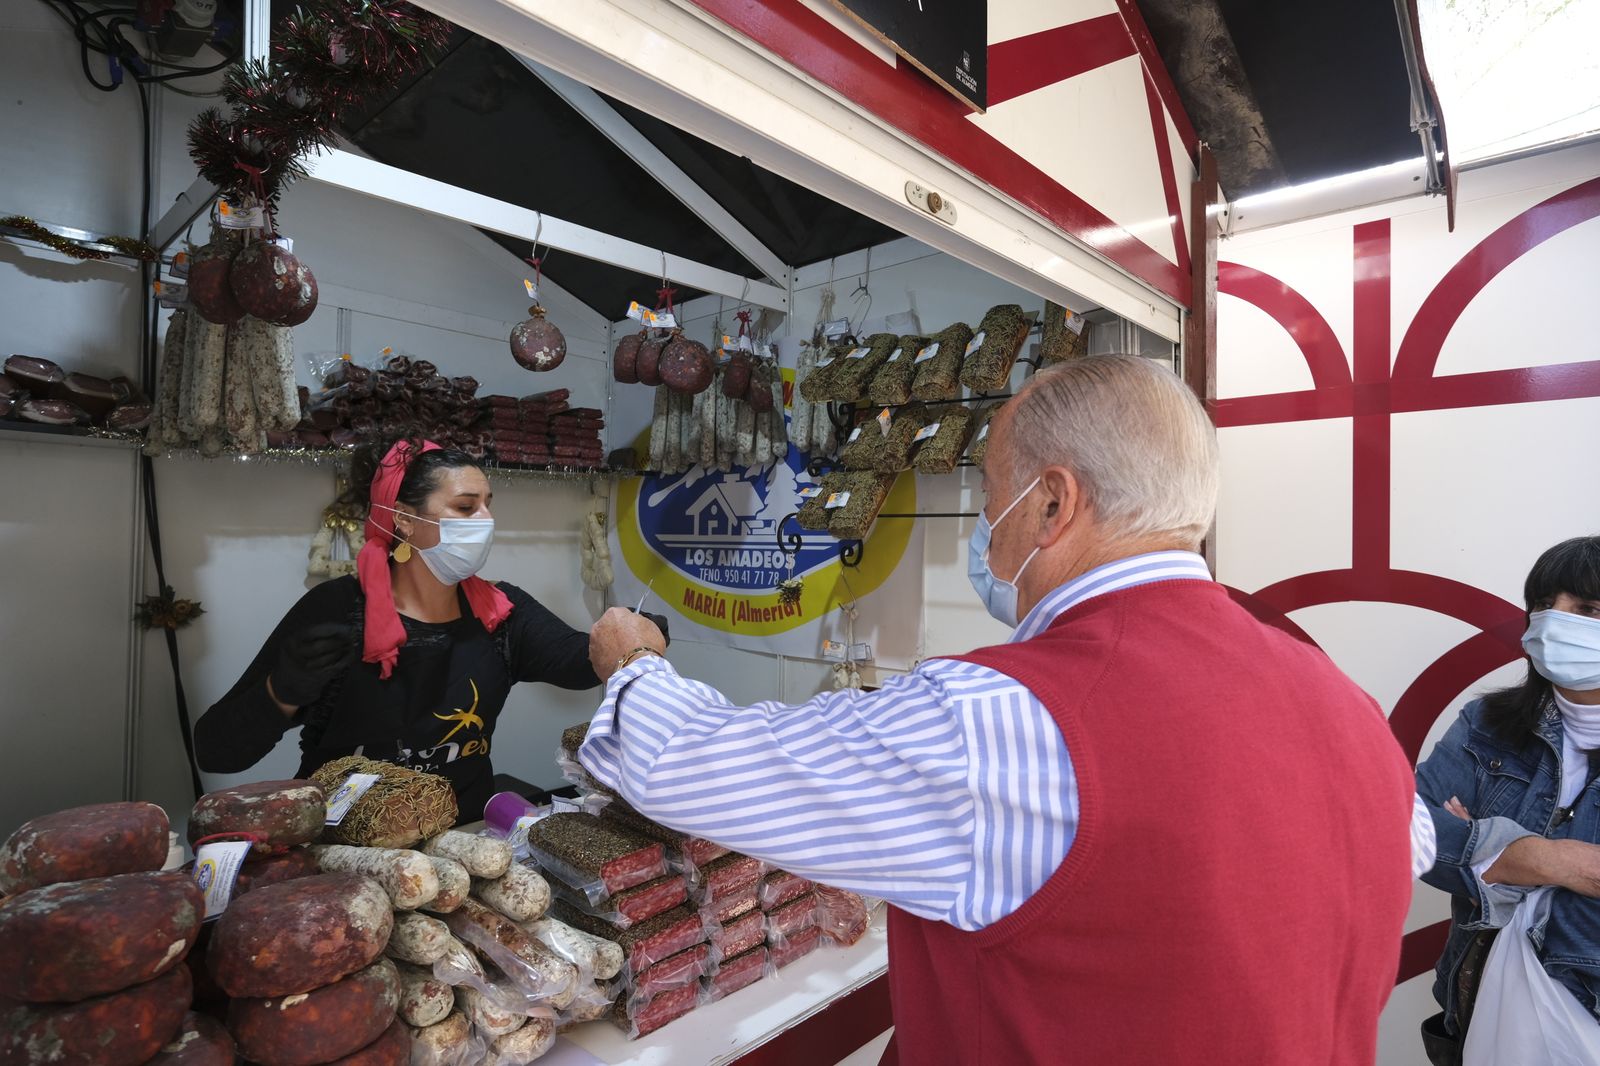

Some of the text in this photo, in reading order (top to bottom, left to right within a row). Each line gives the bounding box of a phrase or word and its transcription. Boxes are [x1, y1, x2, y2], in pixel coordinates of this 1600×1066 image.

[685, 549, 796, 569] LOS AMADEOS
[699, 567, 780, 586] TFNO. 950 41 71 78
[683, 588, 726, 620] MARÍA
